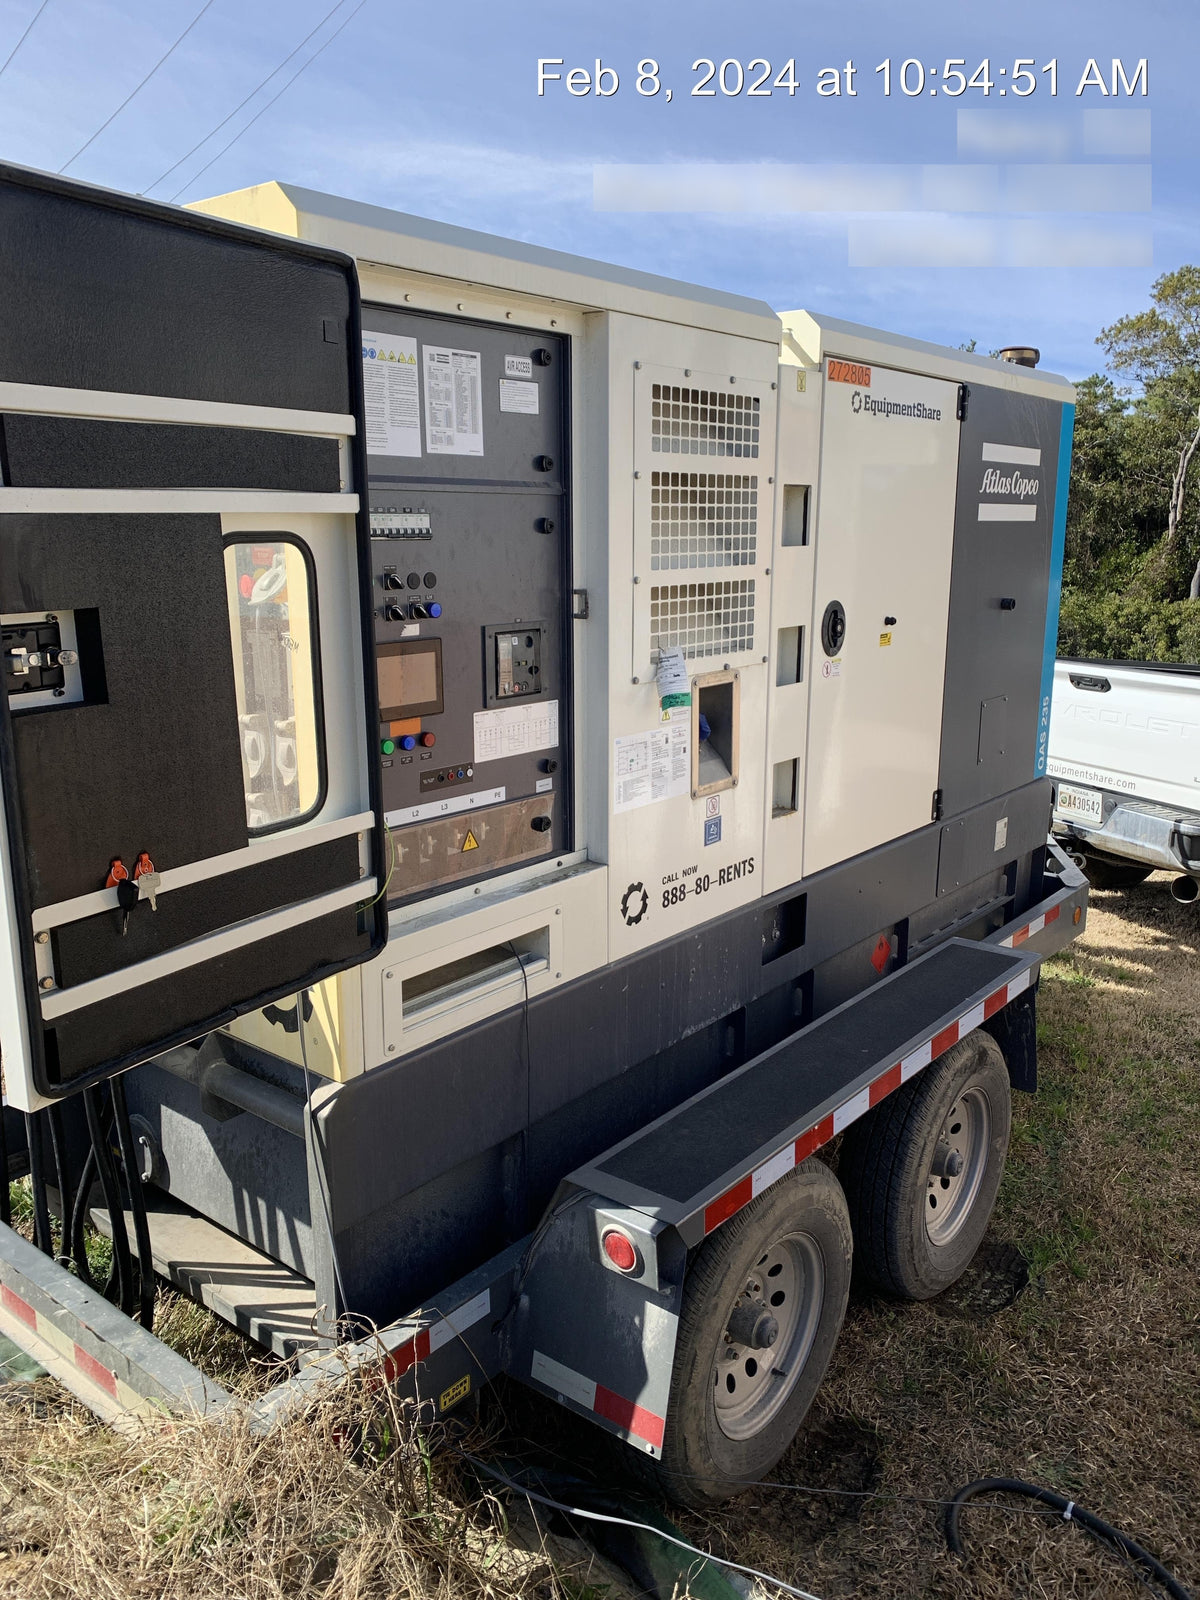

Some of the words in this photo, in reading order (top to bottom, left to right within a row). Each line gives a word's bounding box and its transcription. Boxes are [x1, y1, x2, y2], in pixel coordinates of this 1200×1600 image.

[828, 360, 871, 387] 272805
[863, 394, 942, 421] EquipmentShare
[979, 468, 1011, 495] Atlas
[1011, 470, 1039, 500] Copco
[1037, 731, 1047, 771] QAS
[1042, 695, 1050, 727] 235
[411, 810, 420, 818] L2
[440, 803, 449, 811] L3
[1067, 795, 1100, 815] A430542
[661, 872, 680, 885] CALL
[682, 864, 698, 877] NOW
[661, 857, 755, 909] 888-80-RENTS
